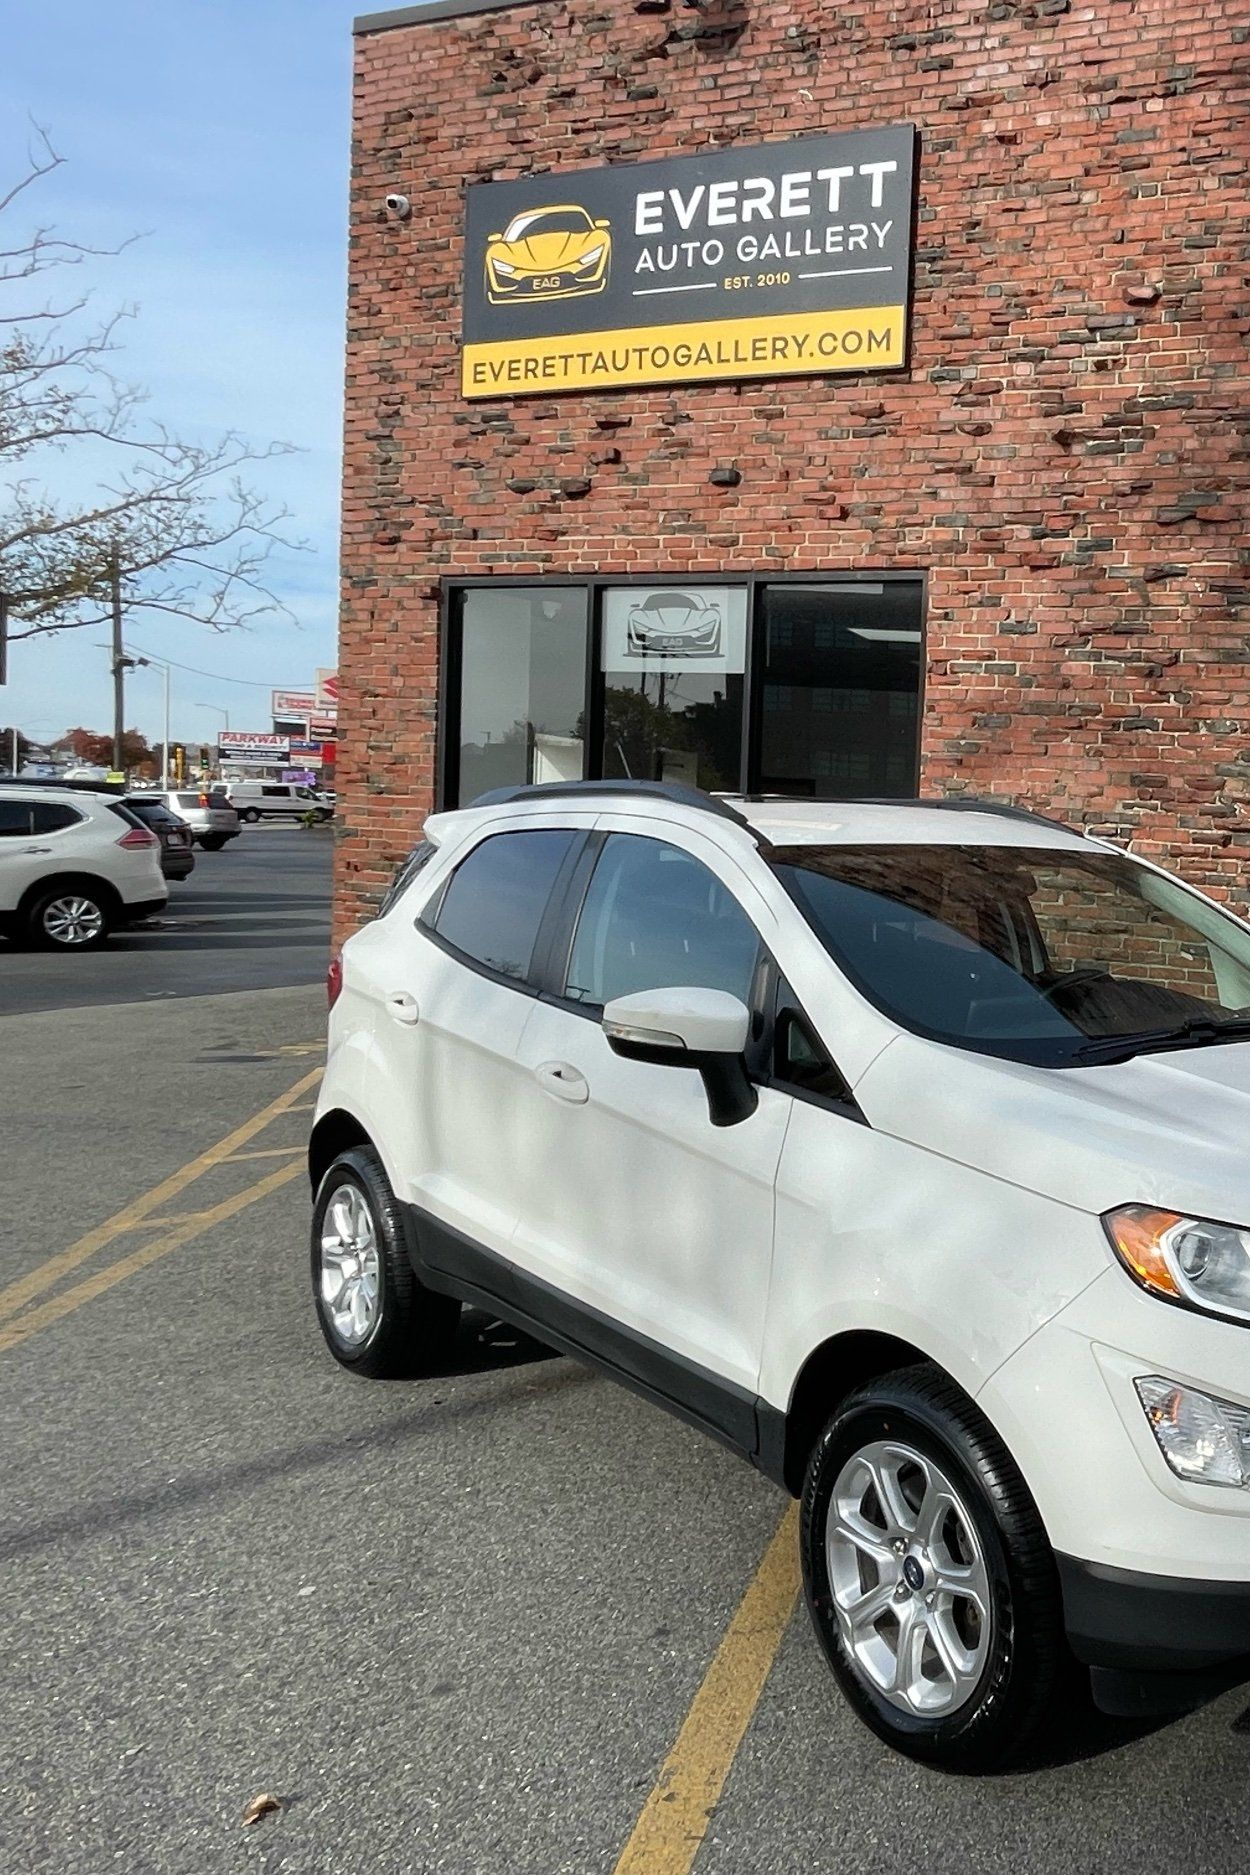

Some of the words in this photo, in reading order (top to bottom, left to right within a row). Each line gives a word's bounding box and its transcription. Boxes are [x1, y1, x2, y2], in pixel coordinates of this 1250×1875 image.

[634, 160, 898, 236] EVERETT
[633, 240, 724, 274] AUTO
[736, 220, 894, 261] GALLERY
[532, 276, 561, 290] EAG
[724, 275, 754, 290] EST.
[757, 271, 791, 288] 2010
[472, 328, 892, 384] EVERETTAUTOGALLERY.COM
[221, 732, 289, 745] PARKWAY
